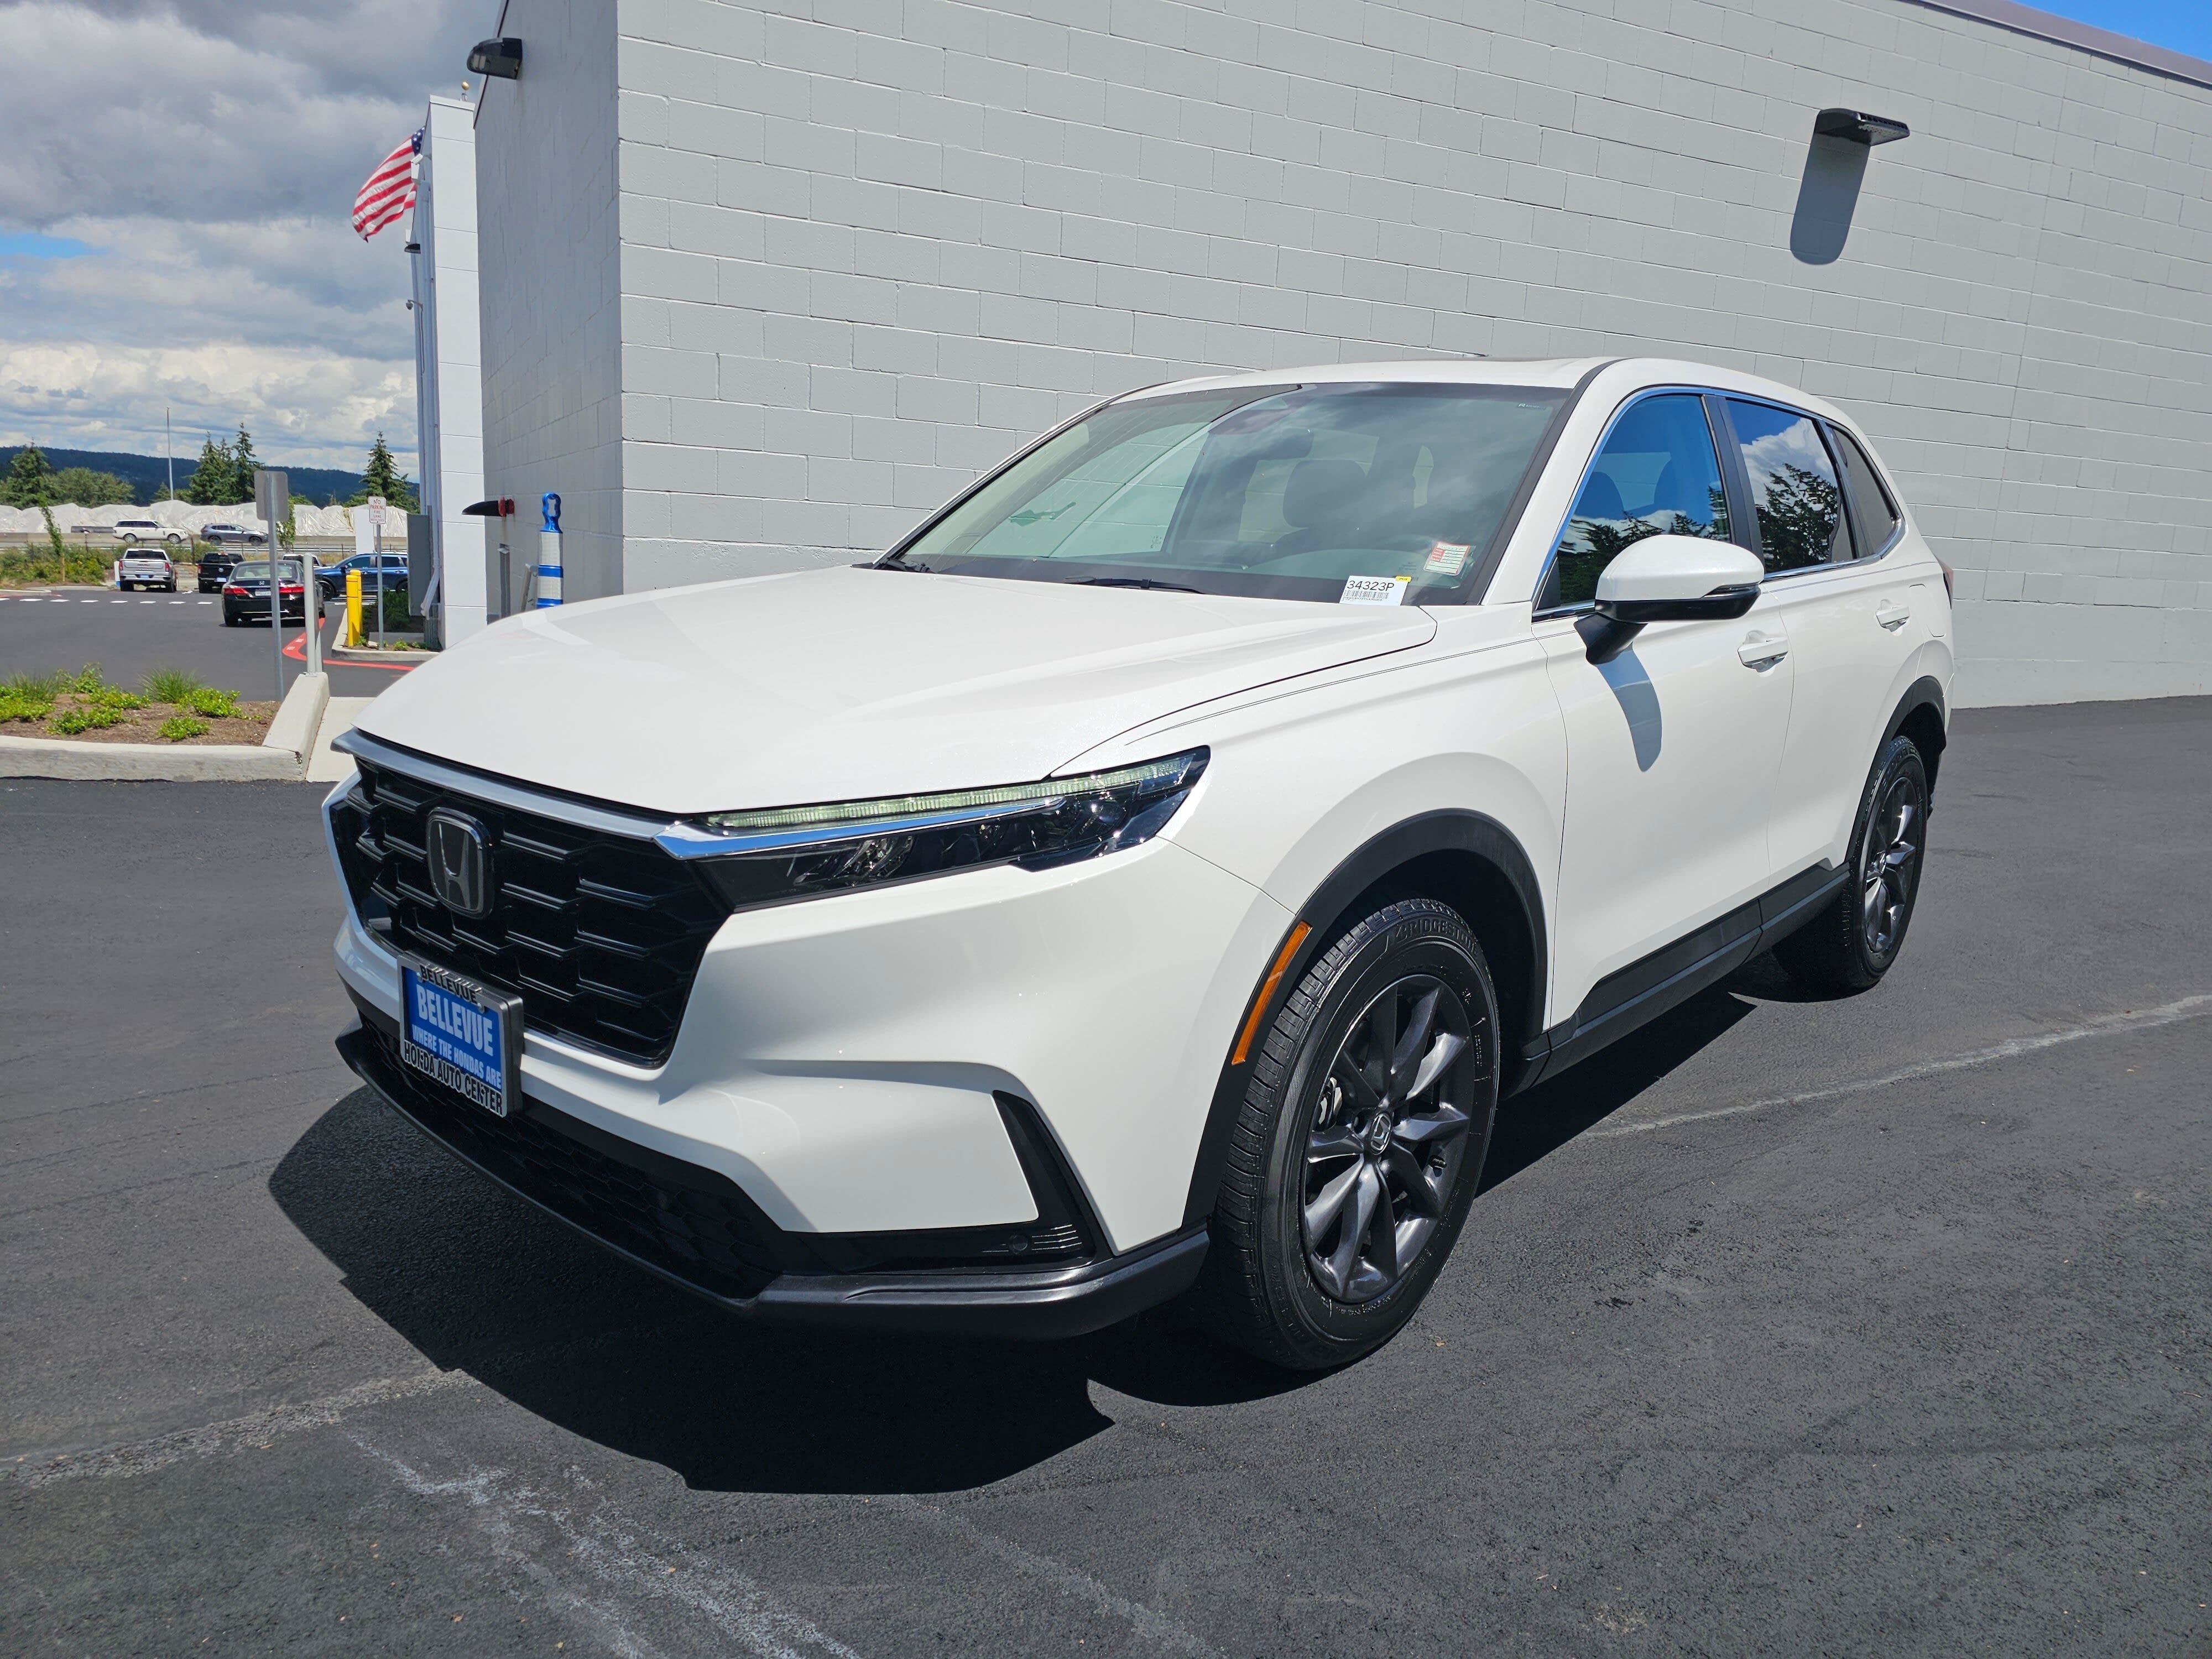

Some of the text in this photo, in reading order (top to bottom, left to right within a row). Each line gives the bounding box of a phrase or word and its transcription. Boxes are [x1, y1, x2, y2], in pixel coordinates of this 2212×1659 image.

[1347, 580, 1395, 592] 34323P
[420, 965, 478, 1005] BELLEVUE
[416, 984, 494, 1057] BELLEVUE
[404, 1040, 503, 1115] HONDA AUTO CENTER
[412, 1024, 502, 1089] WHERE THE HONDAS ARE
